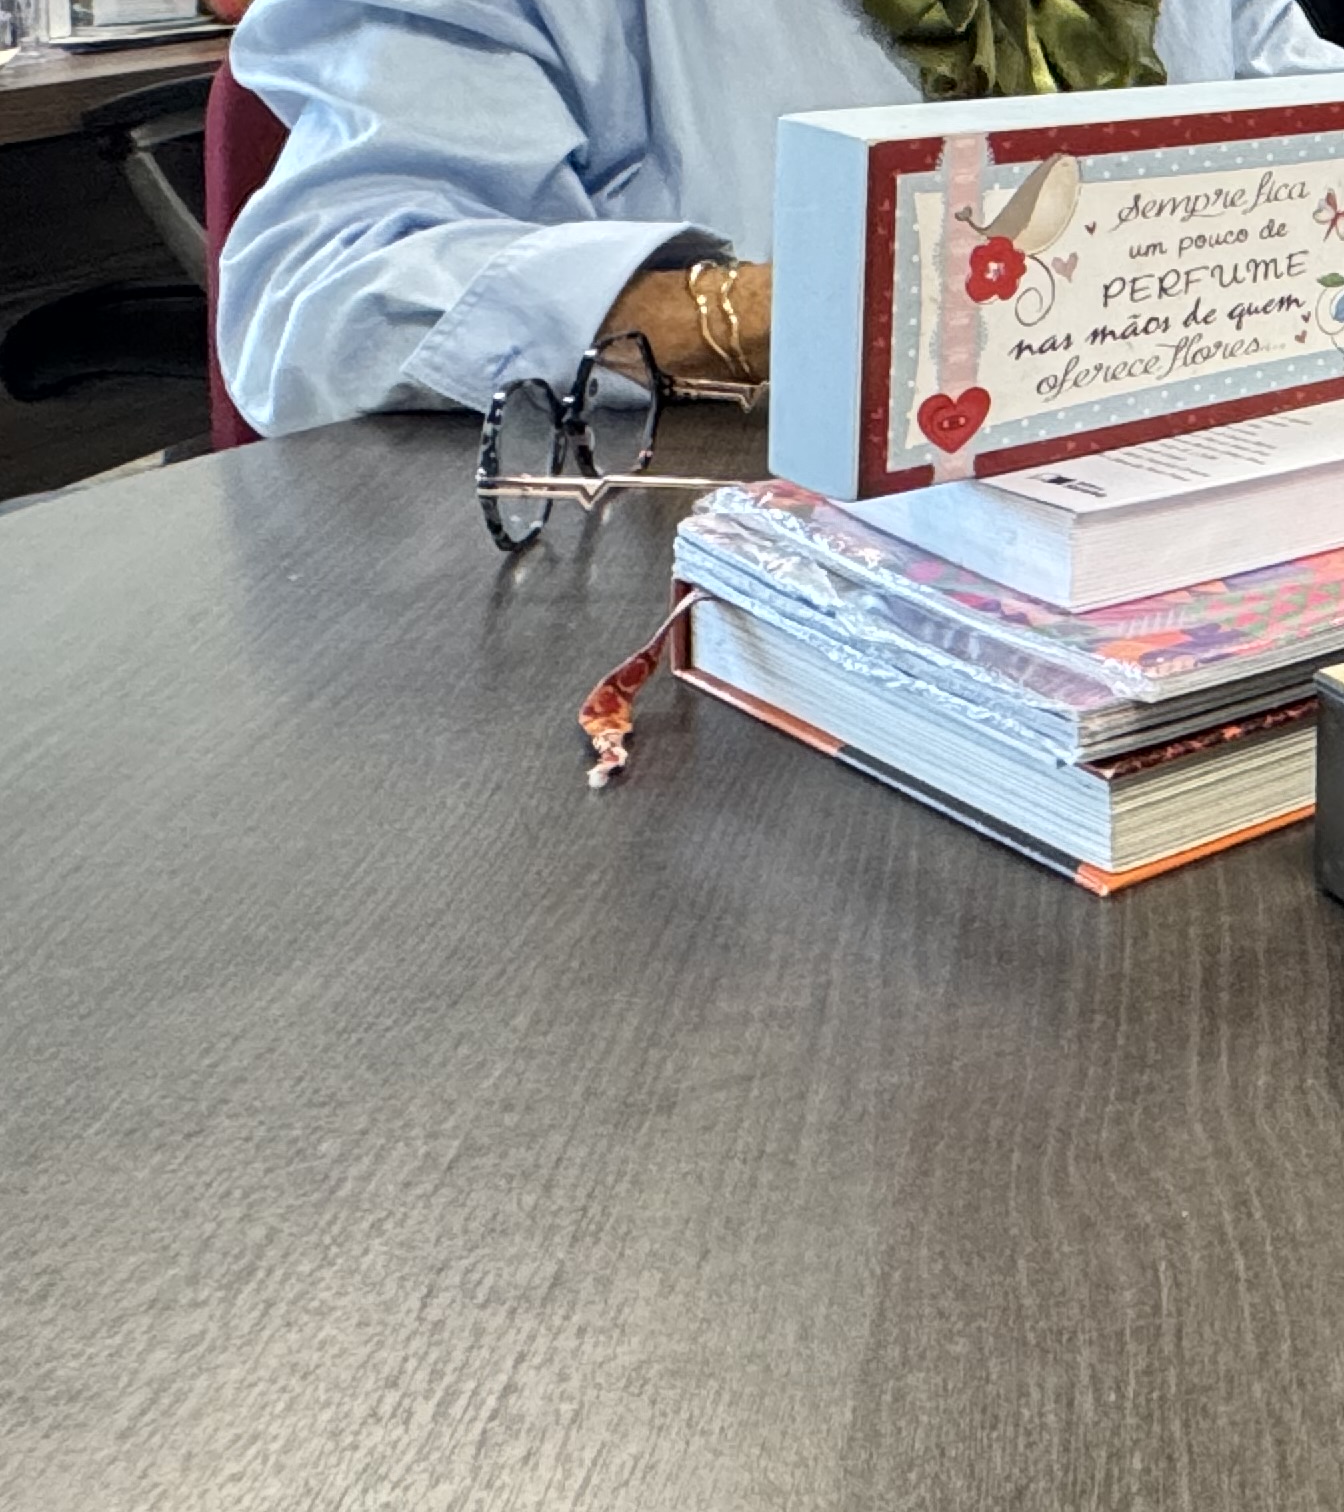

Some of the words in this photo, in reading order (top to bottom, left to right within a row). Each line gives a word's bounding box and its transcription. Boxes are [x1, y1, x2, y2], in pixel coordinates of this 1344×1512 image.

[1108, 188, 1248, 231] Sempre
[1242, 170, 1310, 216] fica
[1128, 242, 1167, 260] um
[1178, 229, 1249, 258] pouco
[1258, 219, 1289, 240] de
[1102, 250, 1310, 308] PERFUME
[1008, 331, 1073, 361] nas
[1084, 314, 1171, 346] mãos
[1182, 297, 1217, 328] de
[1226, 294, 1306, 330] quem
[1036, 355, 1164, 404] oferece
